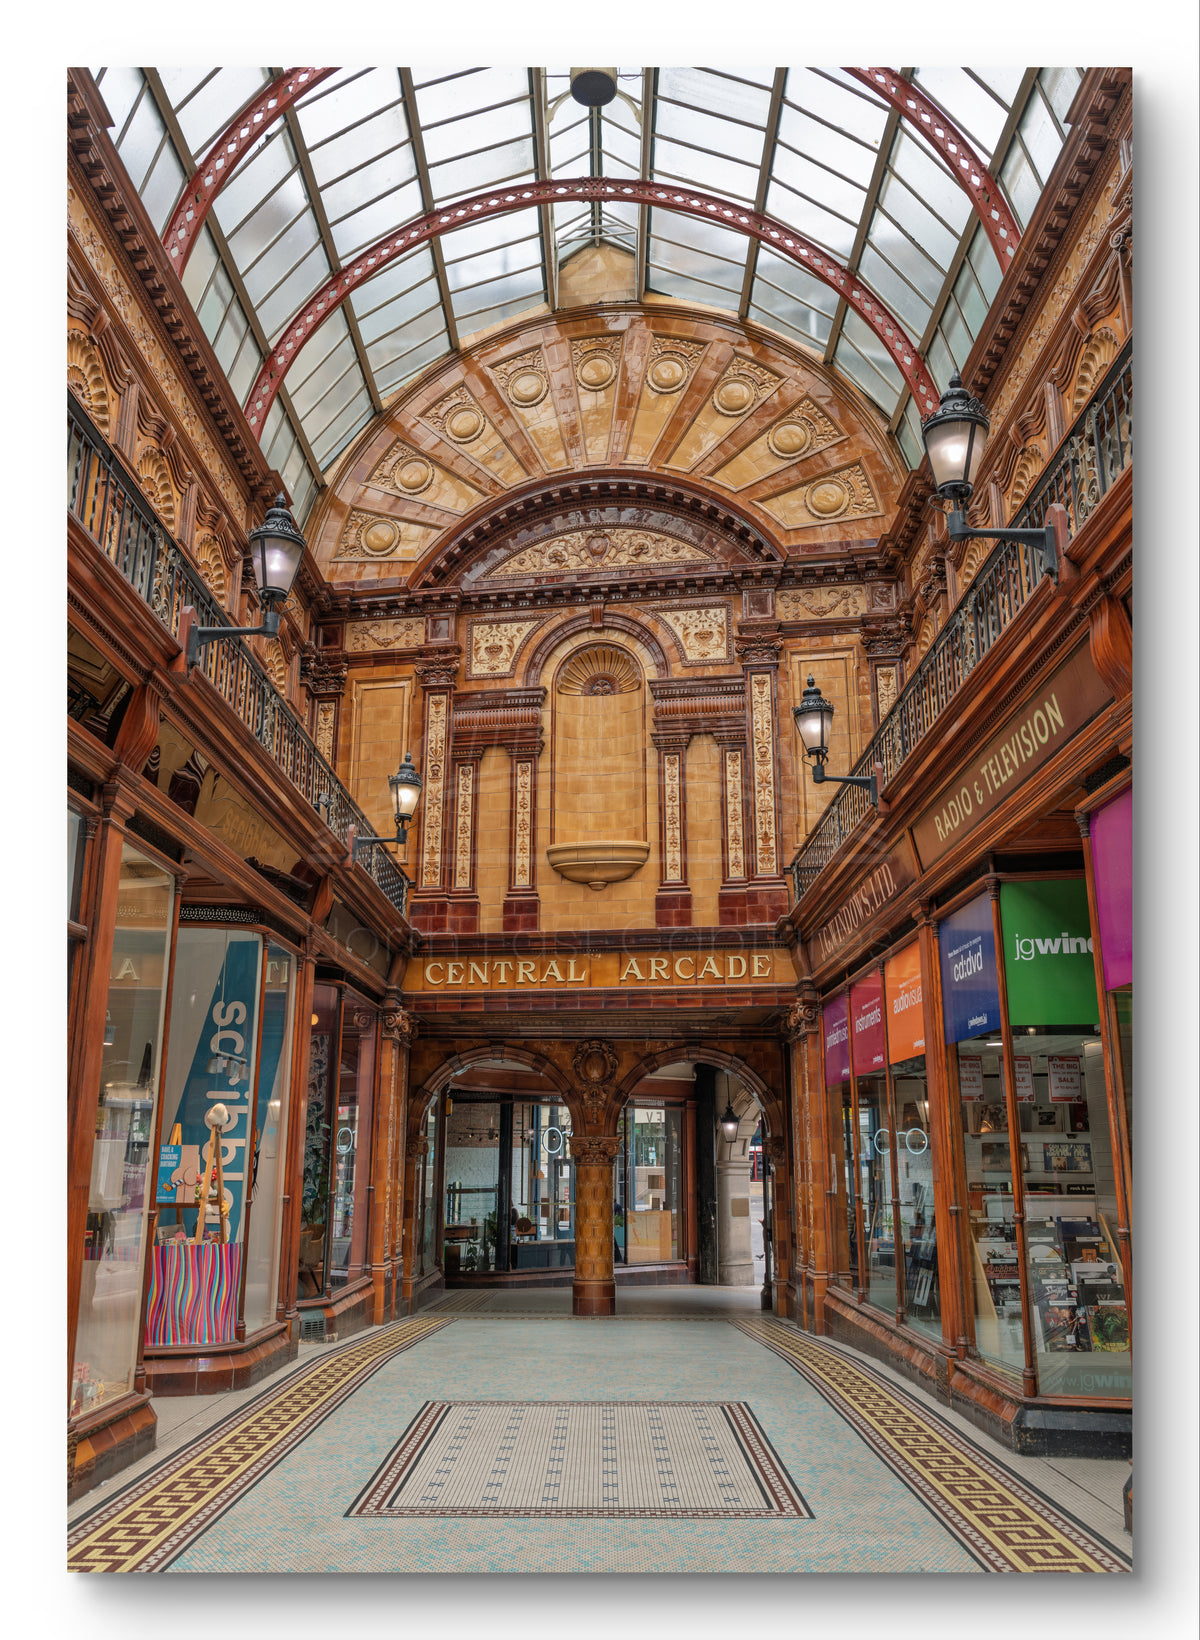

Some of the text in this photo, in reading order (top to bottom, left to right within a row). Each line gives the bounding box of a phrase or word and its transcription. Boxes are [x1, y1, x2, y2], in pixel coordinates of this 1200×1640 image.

[934, 693, 1065, 842] RADIO & TELEVISION
[425, 954, 772, 985] CENTRAL ARCADE
[953, 944, 983, 982] cd:dvd
[893, 986, 923, 1014] audiovisua
